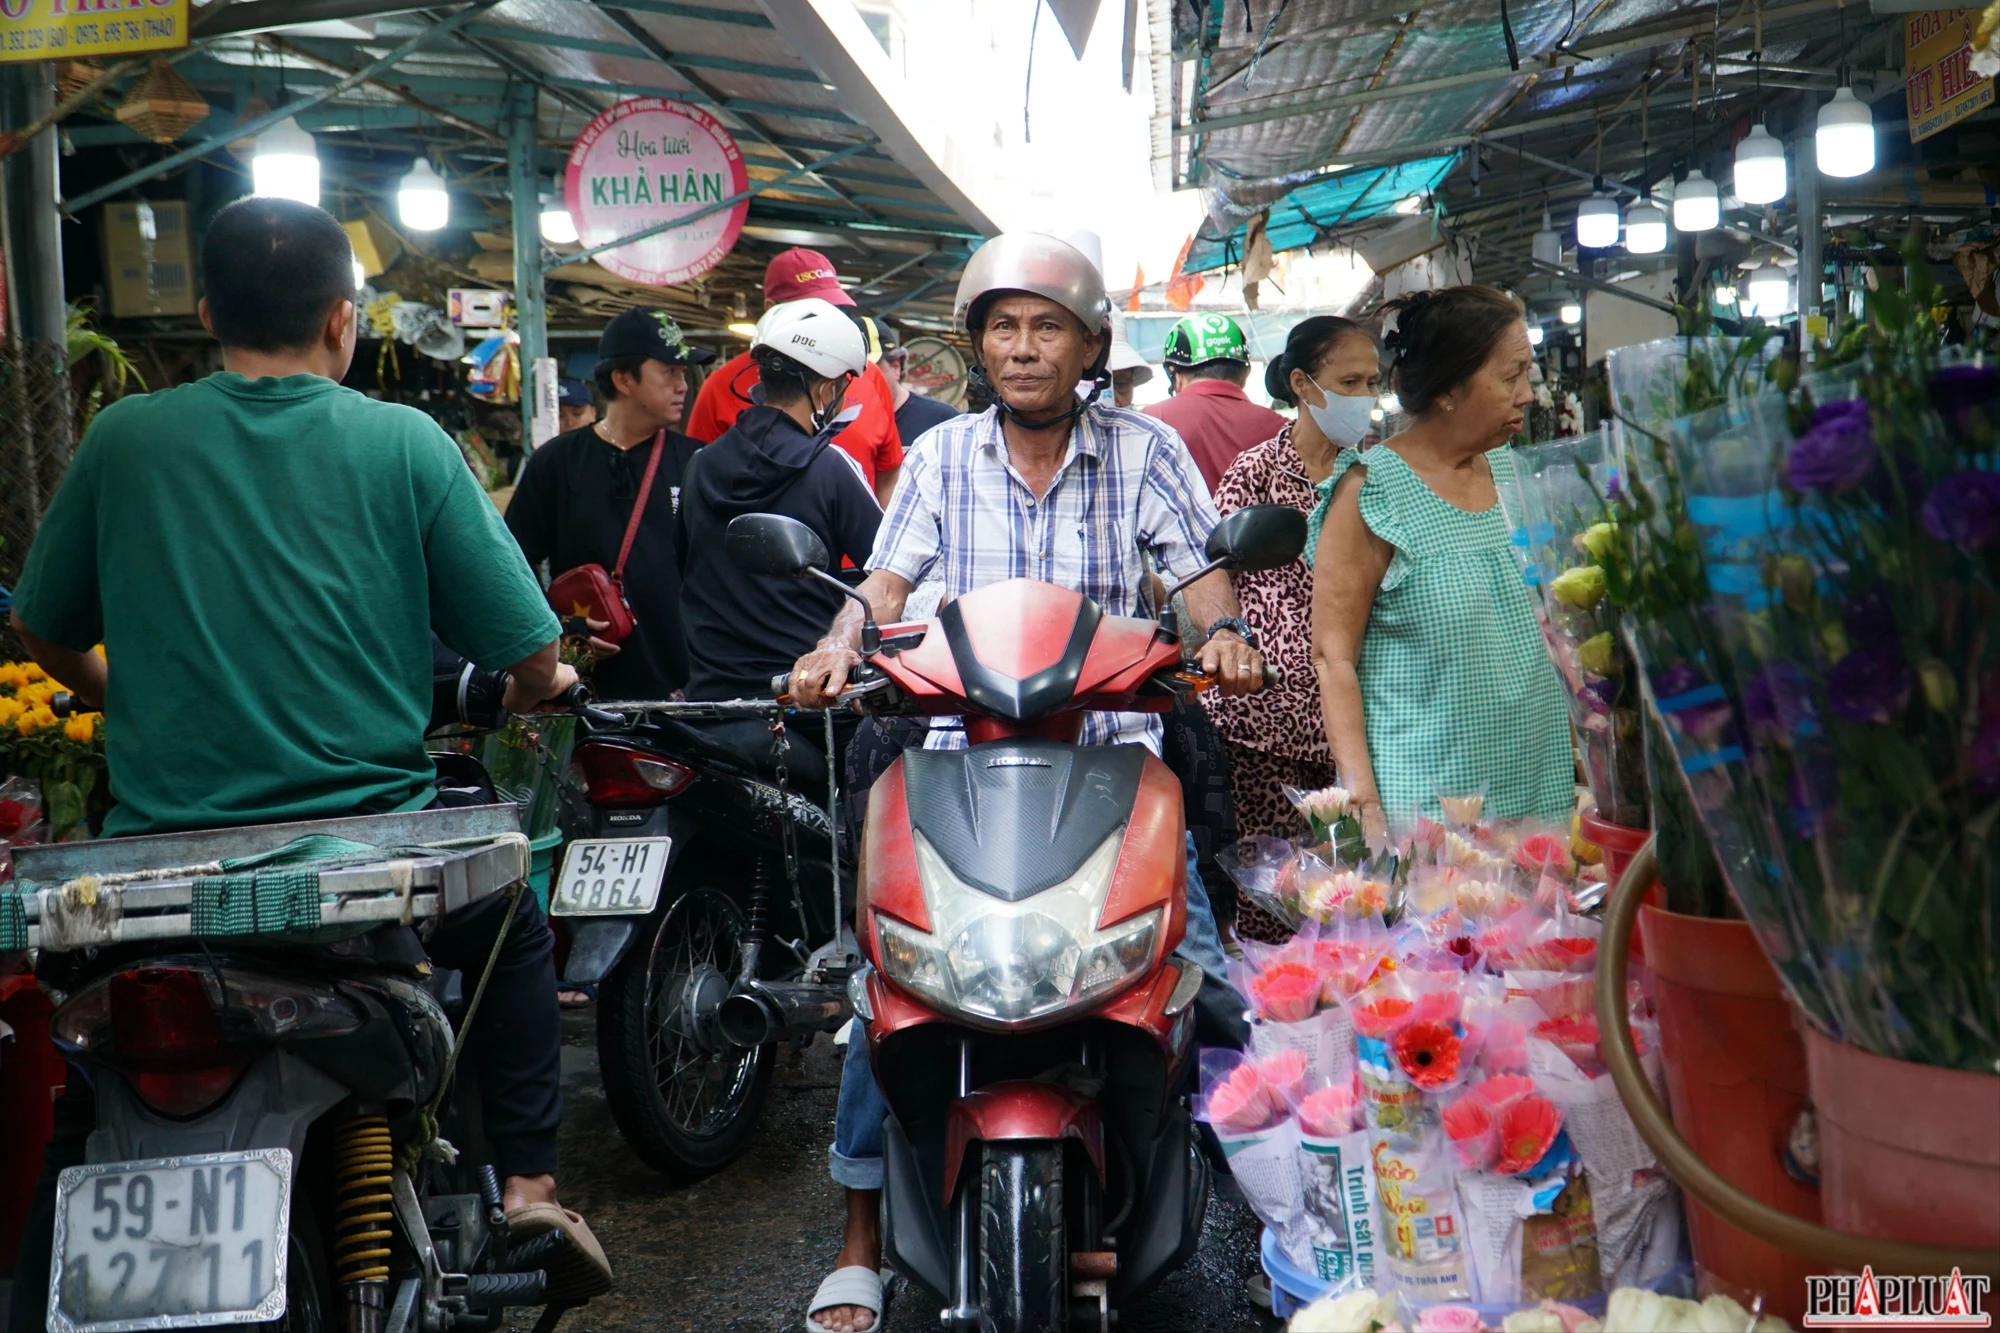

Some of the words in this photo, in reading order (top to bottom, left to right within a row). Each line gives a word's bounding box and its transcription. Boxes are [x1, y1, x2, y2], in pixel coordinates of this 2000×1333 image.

[617, 129, 660, 162] Hoa
[661, 130, 693, 156] tươi
[591, 166, 653, 206] KHẢ
[659, 167, 724, 204] HÂN
[1206, 335, 1232, 348] gojek
[609, 814, 642, 822] HONDA
[570, 877, 642, 909] 9864
